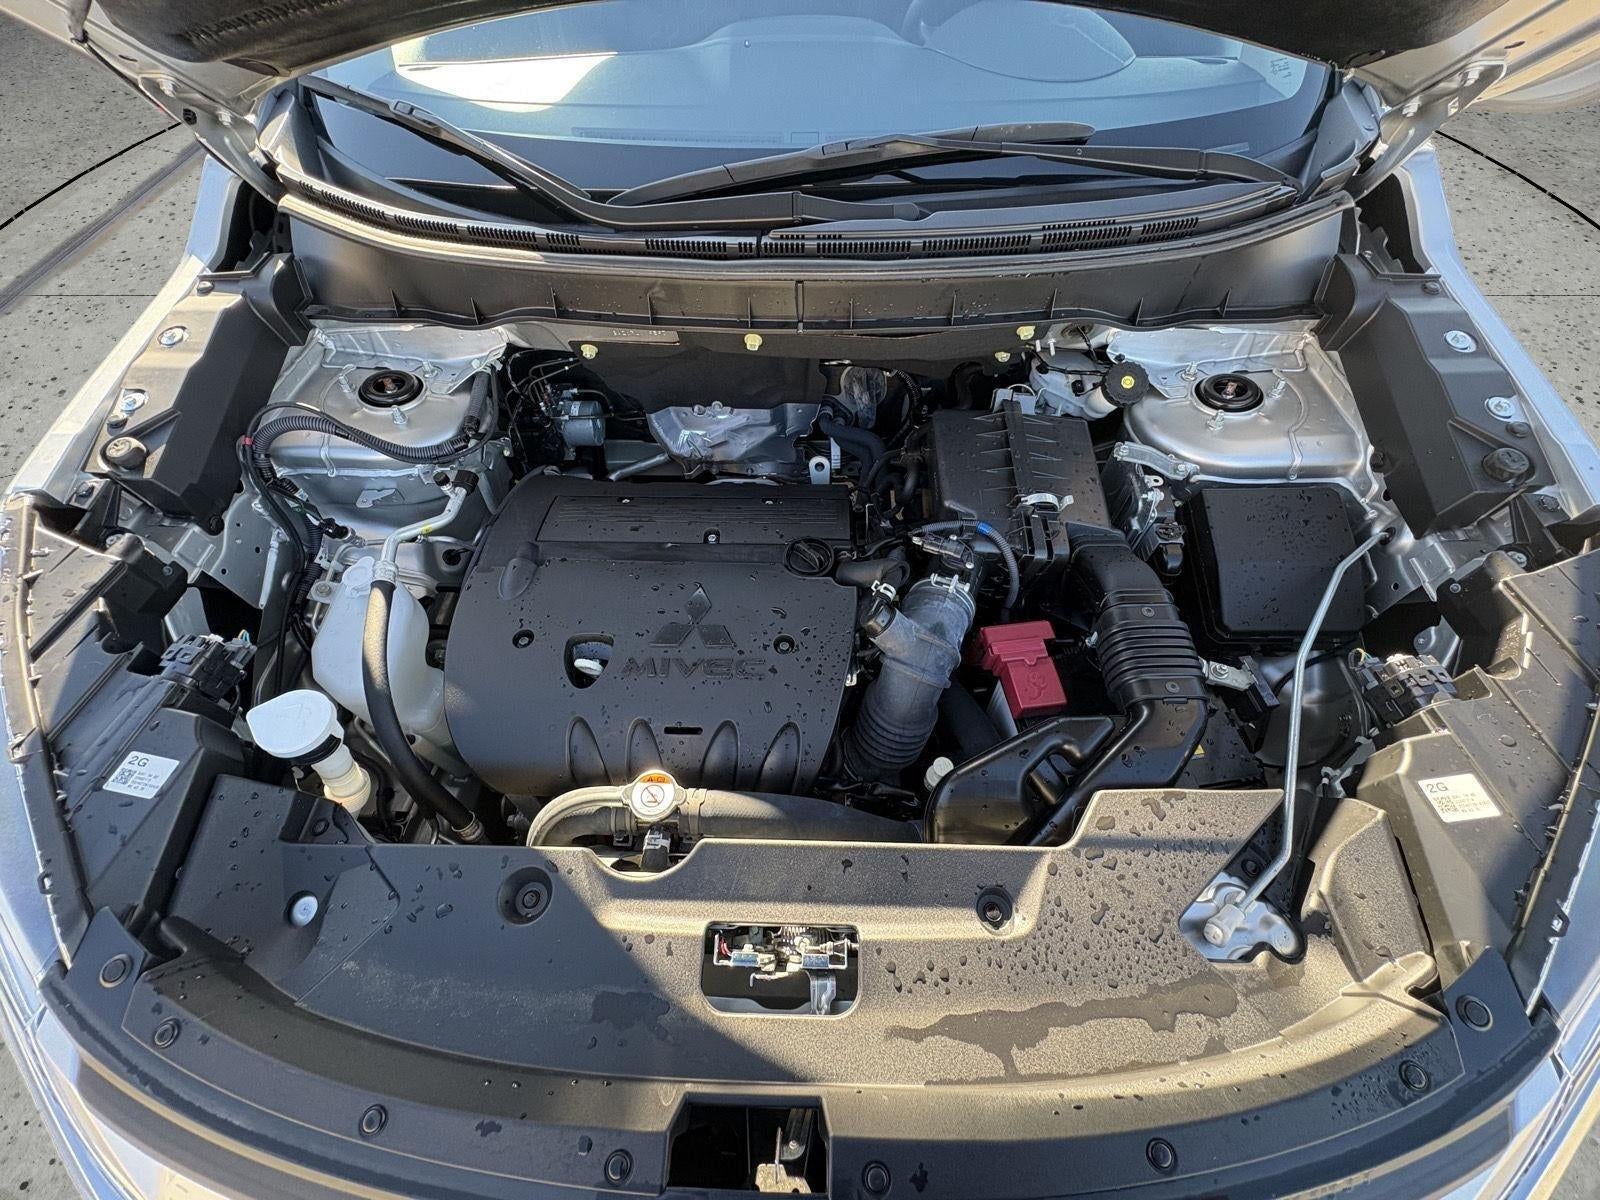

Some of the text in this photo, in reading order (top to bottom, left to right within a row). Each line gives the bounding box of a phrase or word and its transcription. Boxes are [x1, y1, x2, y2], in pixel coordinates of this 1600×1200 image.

[621, 657, 766, 680] MIVEC
[128, 755, 150, 768] 2G
[1426, 782, 1449, 794] 2G
